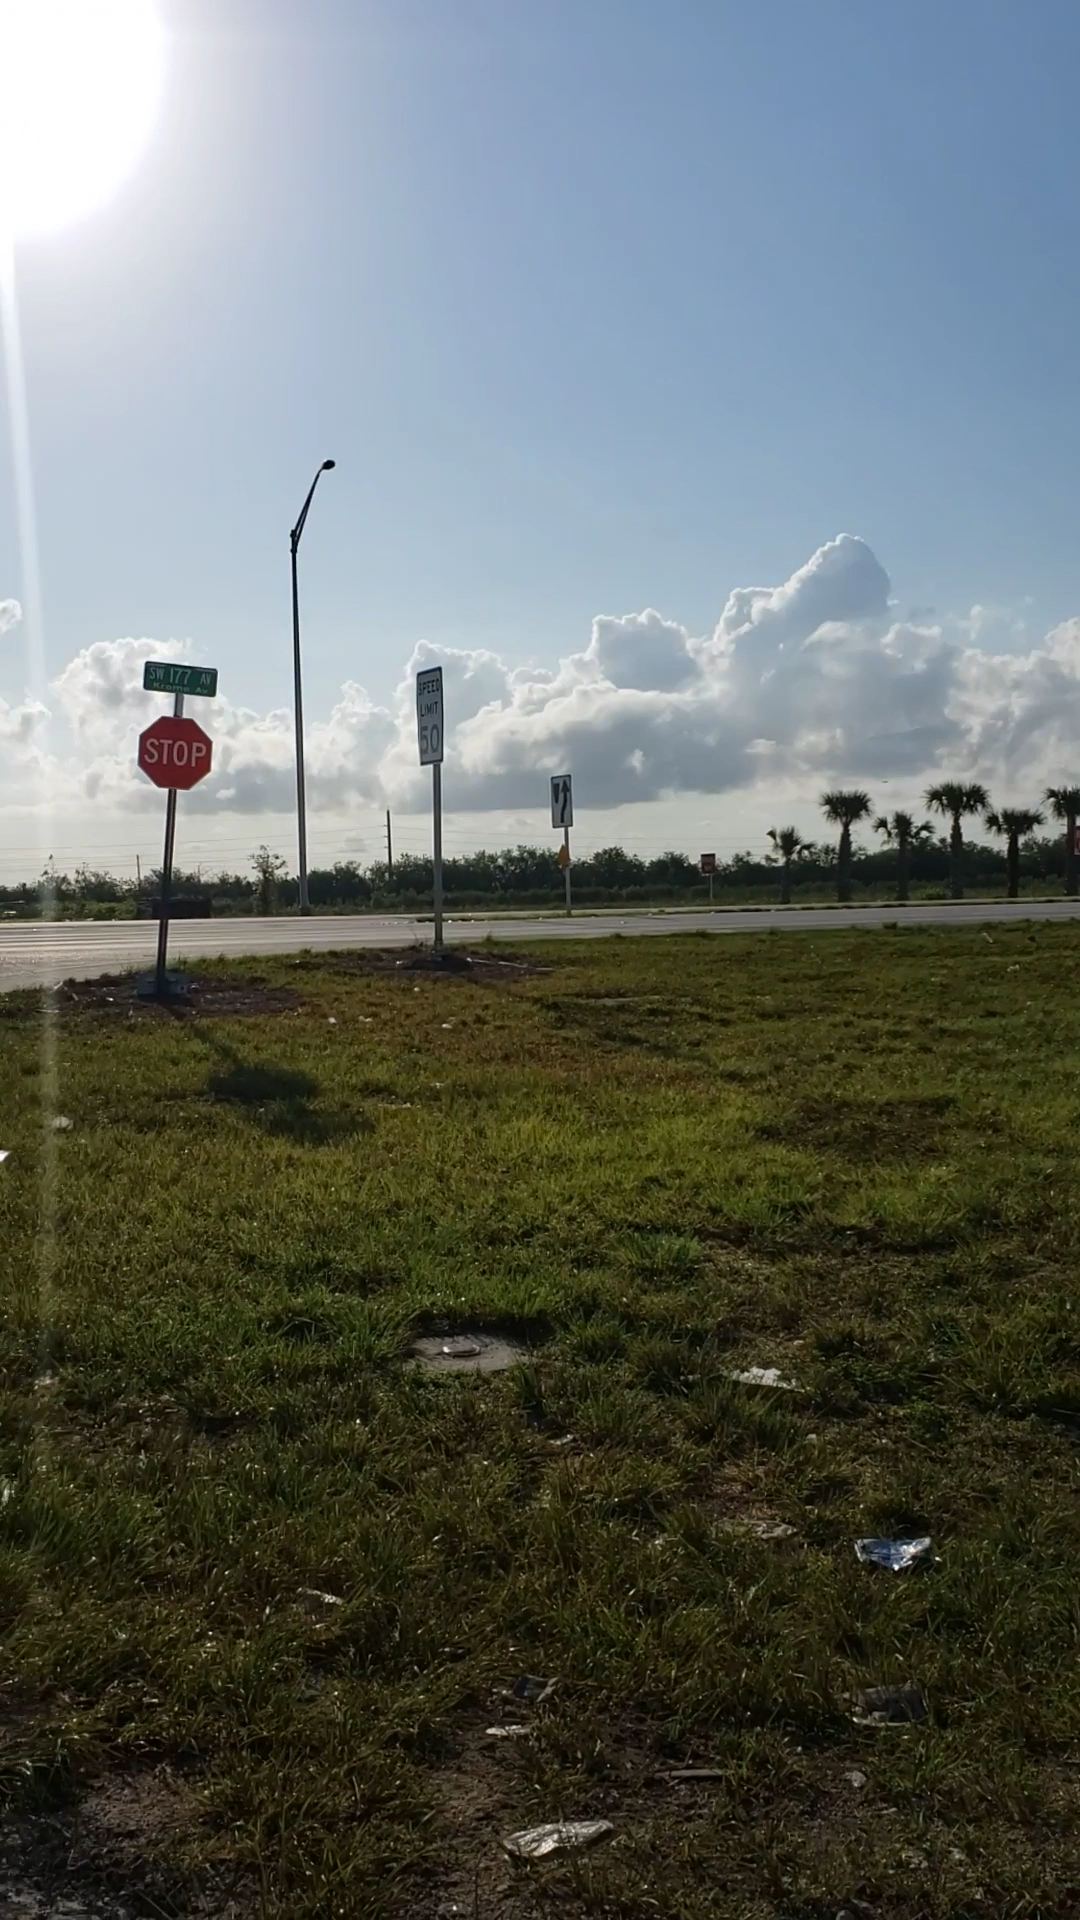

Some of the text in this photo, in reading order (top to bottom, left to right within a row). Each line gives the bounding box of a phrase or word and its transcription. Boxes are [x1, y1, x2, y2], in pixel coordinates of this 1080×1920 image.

[149, 668, 211, 685] SW 177 AV
[418, 678, 440, 696] SPEED
[420, 701, 439, 717] LIMIT
[420, 723, 440, 755] 50
[144, 738, 207, 767] STOP
